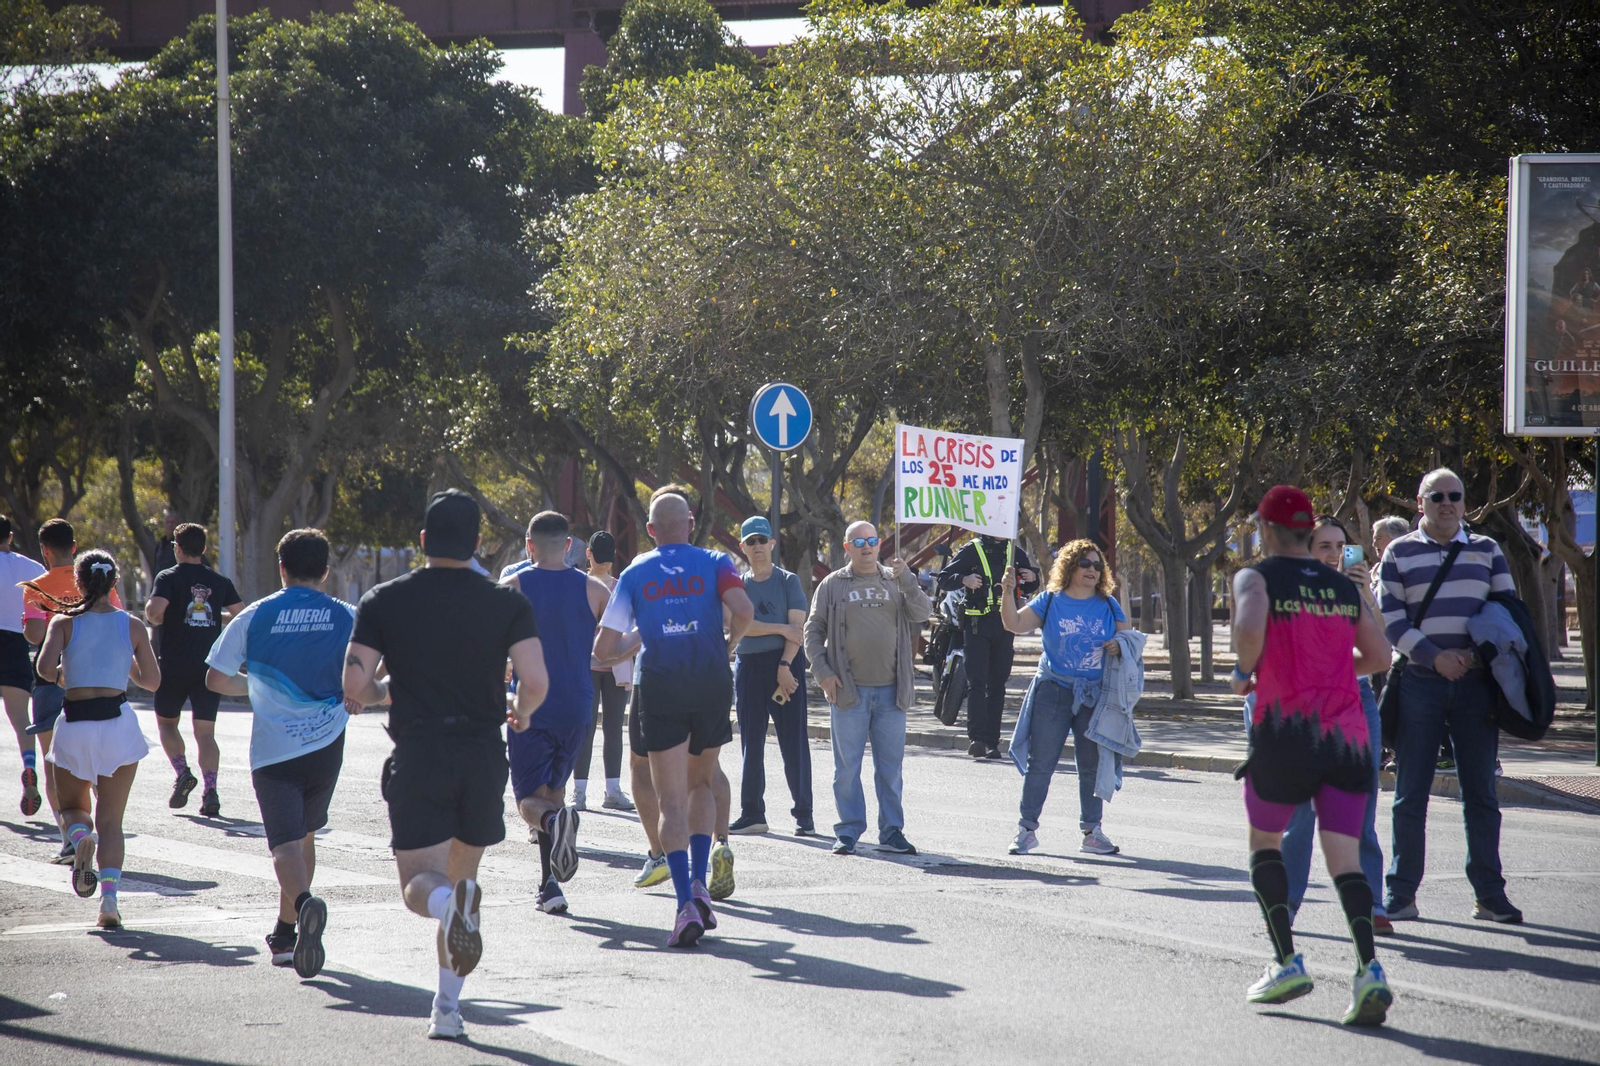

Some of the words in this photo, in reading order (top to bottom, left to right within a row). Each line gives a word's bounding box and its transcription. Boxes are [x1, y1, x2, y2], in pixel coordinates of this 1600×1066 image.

[902, 431, 928, 458] LA
[1001, 450, 1017, 462] DE
[902, 461, 924, 473] LOS
[928, 460, 956, 487] 25
[963, 475, 979, 489] ME
[983, 475, 1008, 490] HIZO
[904, 486, 987, 526] RUNNER
[643, 575, 705, 601] GALO
[1299, 585, 1315, 599] EL
[1319, 588, 1335, 600] 18
[275, 607, 331, 624] ALMERÍA
[1303, 602, 1358, 617] VILLARES
[270, 624, 285, 634] MÁS
[285, 623, 300, 633] ALLÁ
[300, 624, 310, 632] DEL
[311, 623, 335, 631] ASFALTO
